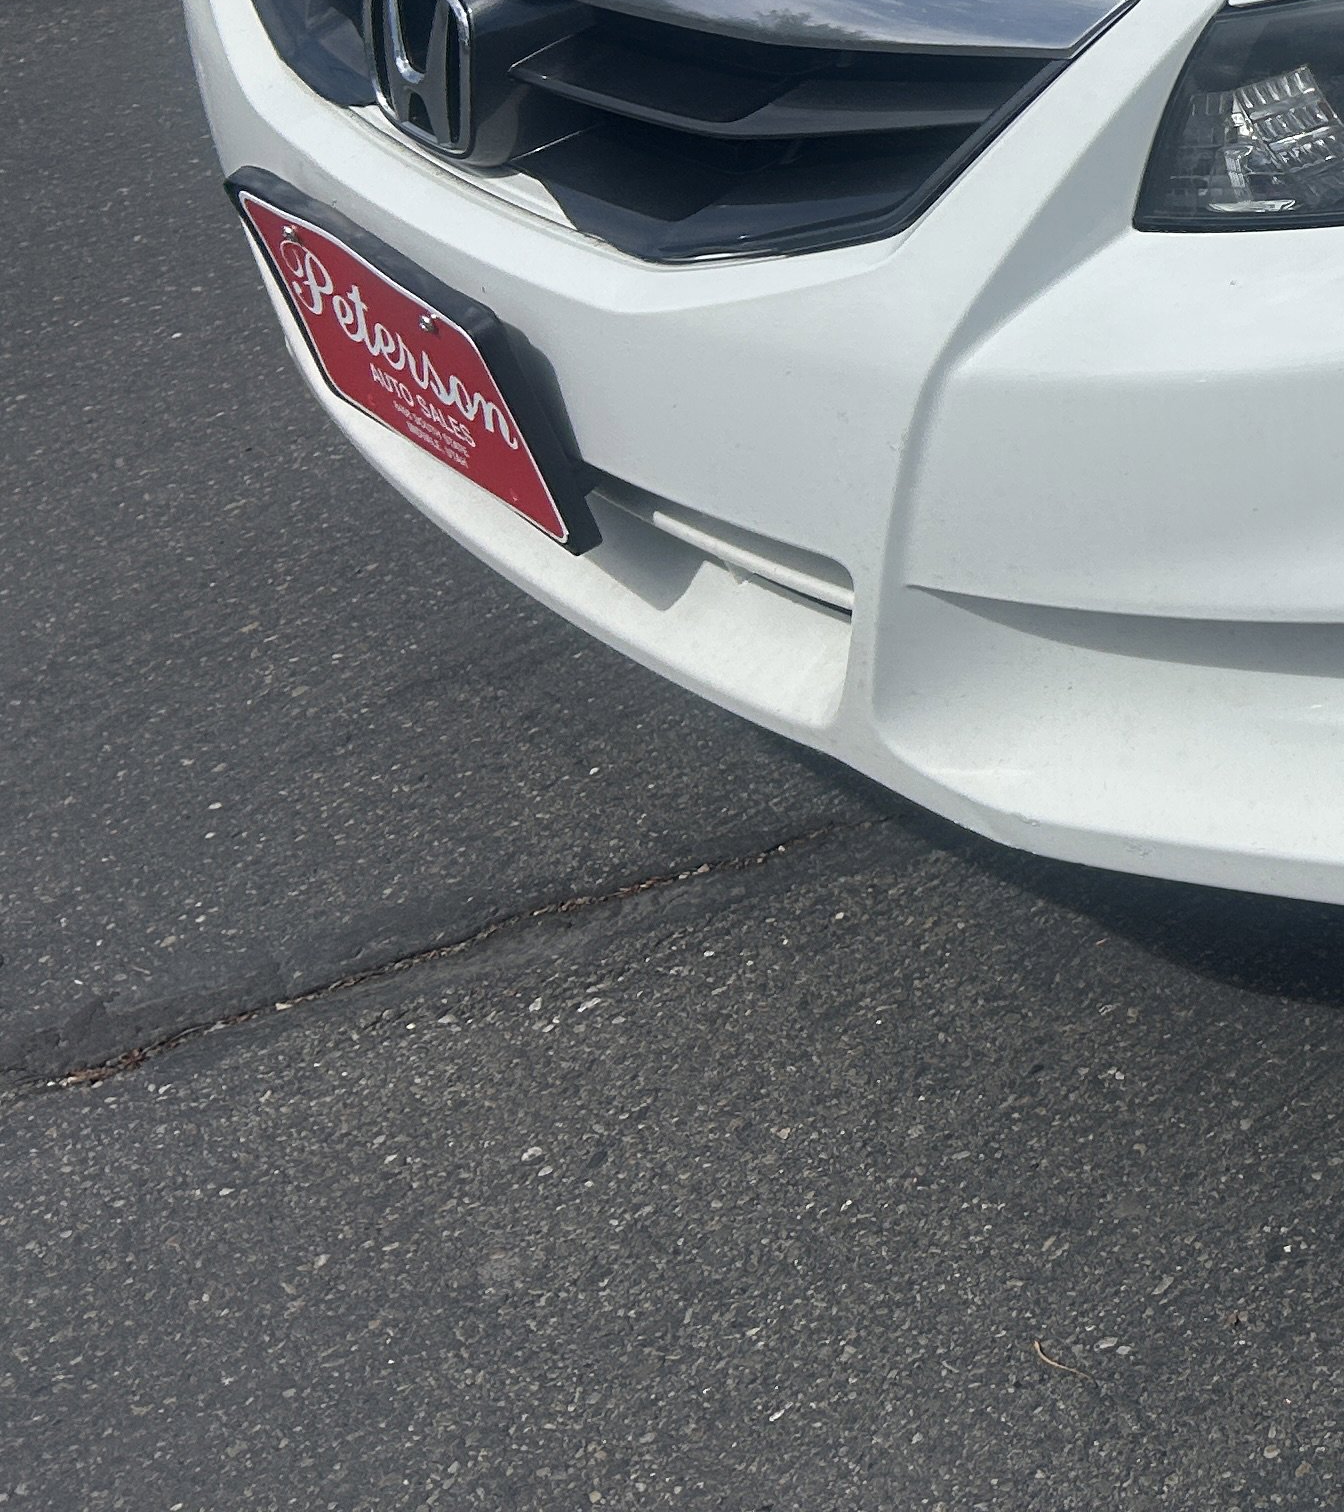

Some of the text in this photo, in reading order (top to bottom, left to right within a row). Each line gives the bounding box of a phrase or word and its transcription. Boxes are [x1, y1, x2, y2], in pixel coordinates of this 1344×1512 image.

[279, 239, 519, 450] Peterson
[370, 362, 415, 407] AUTO
[416, 394, 476, 448] SALES
